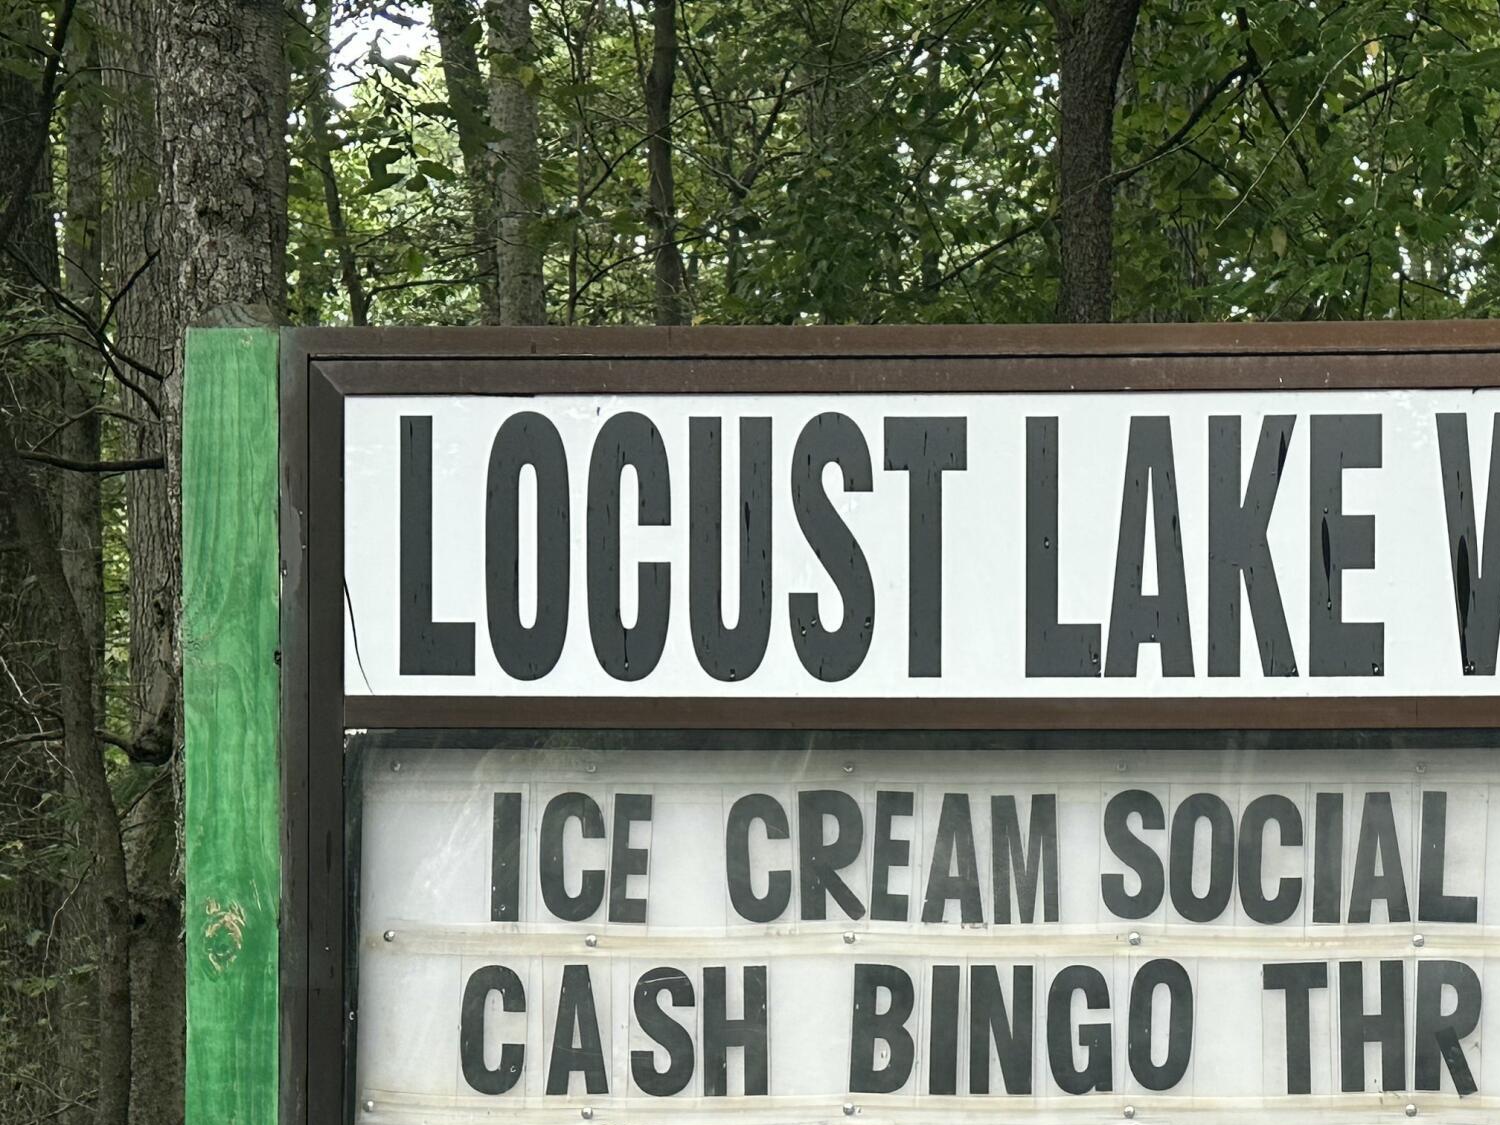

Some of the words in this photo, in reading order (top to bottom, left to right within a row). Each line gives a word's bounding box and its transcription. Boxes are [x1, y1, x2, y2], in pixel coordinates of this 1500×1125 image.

[400, 411, 967, 682] LOCUST
[1025, 414, 1384, 678] LAKE
[490, 791, 653, 923] ICE
[726, 789, 1060, 925] CREAM
[1101, 790, 1478, 923] SOCIAL
[460, 965, 769, 1097] CASH
[849, 958, 1195, 1096] BINGO
[1263, 959, 1482, 1096] THR
